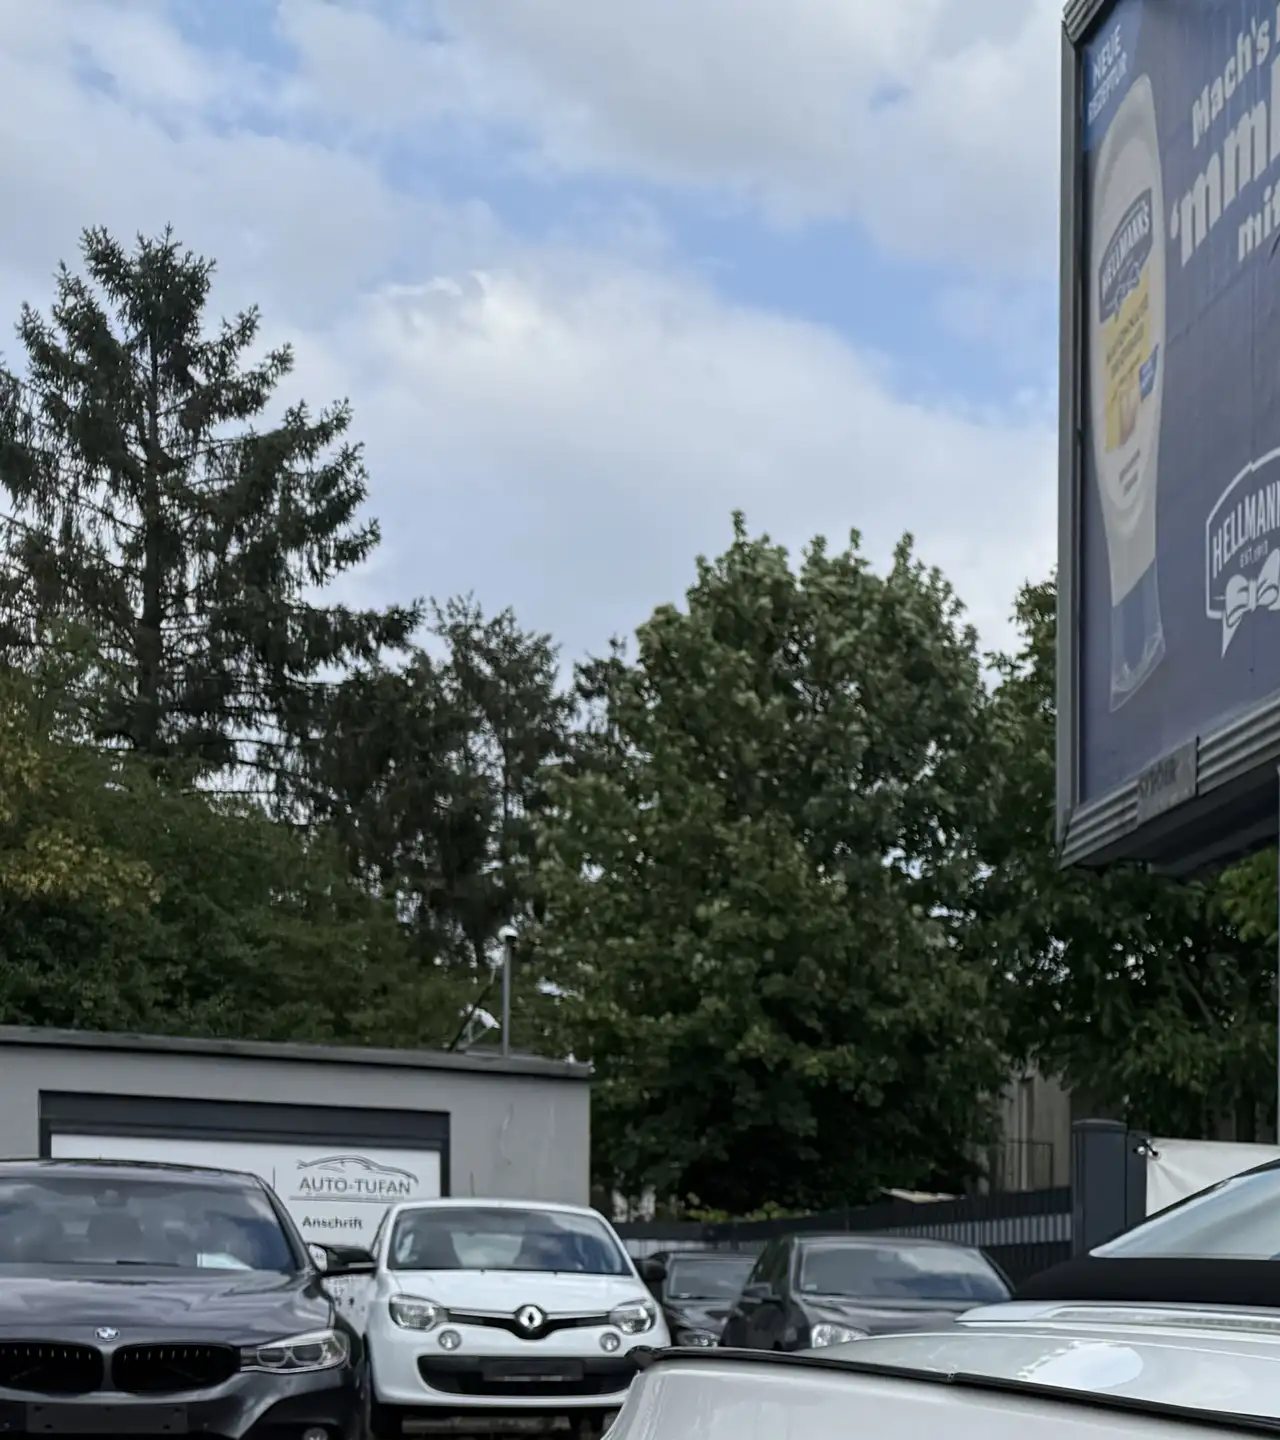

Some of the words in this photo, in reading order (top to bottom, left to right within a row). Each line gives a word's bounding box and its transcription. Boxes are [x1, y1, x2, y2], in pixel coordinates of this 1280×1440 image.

[1092, 24, 1121, 90] NEUE
[1192, 16, 1270, 149] Mach's
[299, 1176, 411, 1195] AUTO-TUFAN
[302, 1216, 363, 1230] Anschrift
